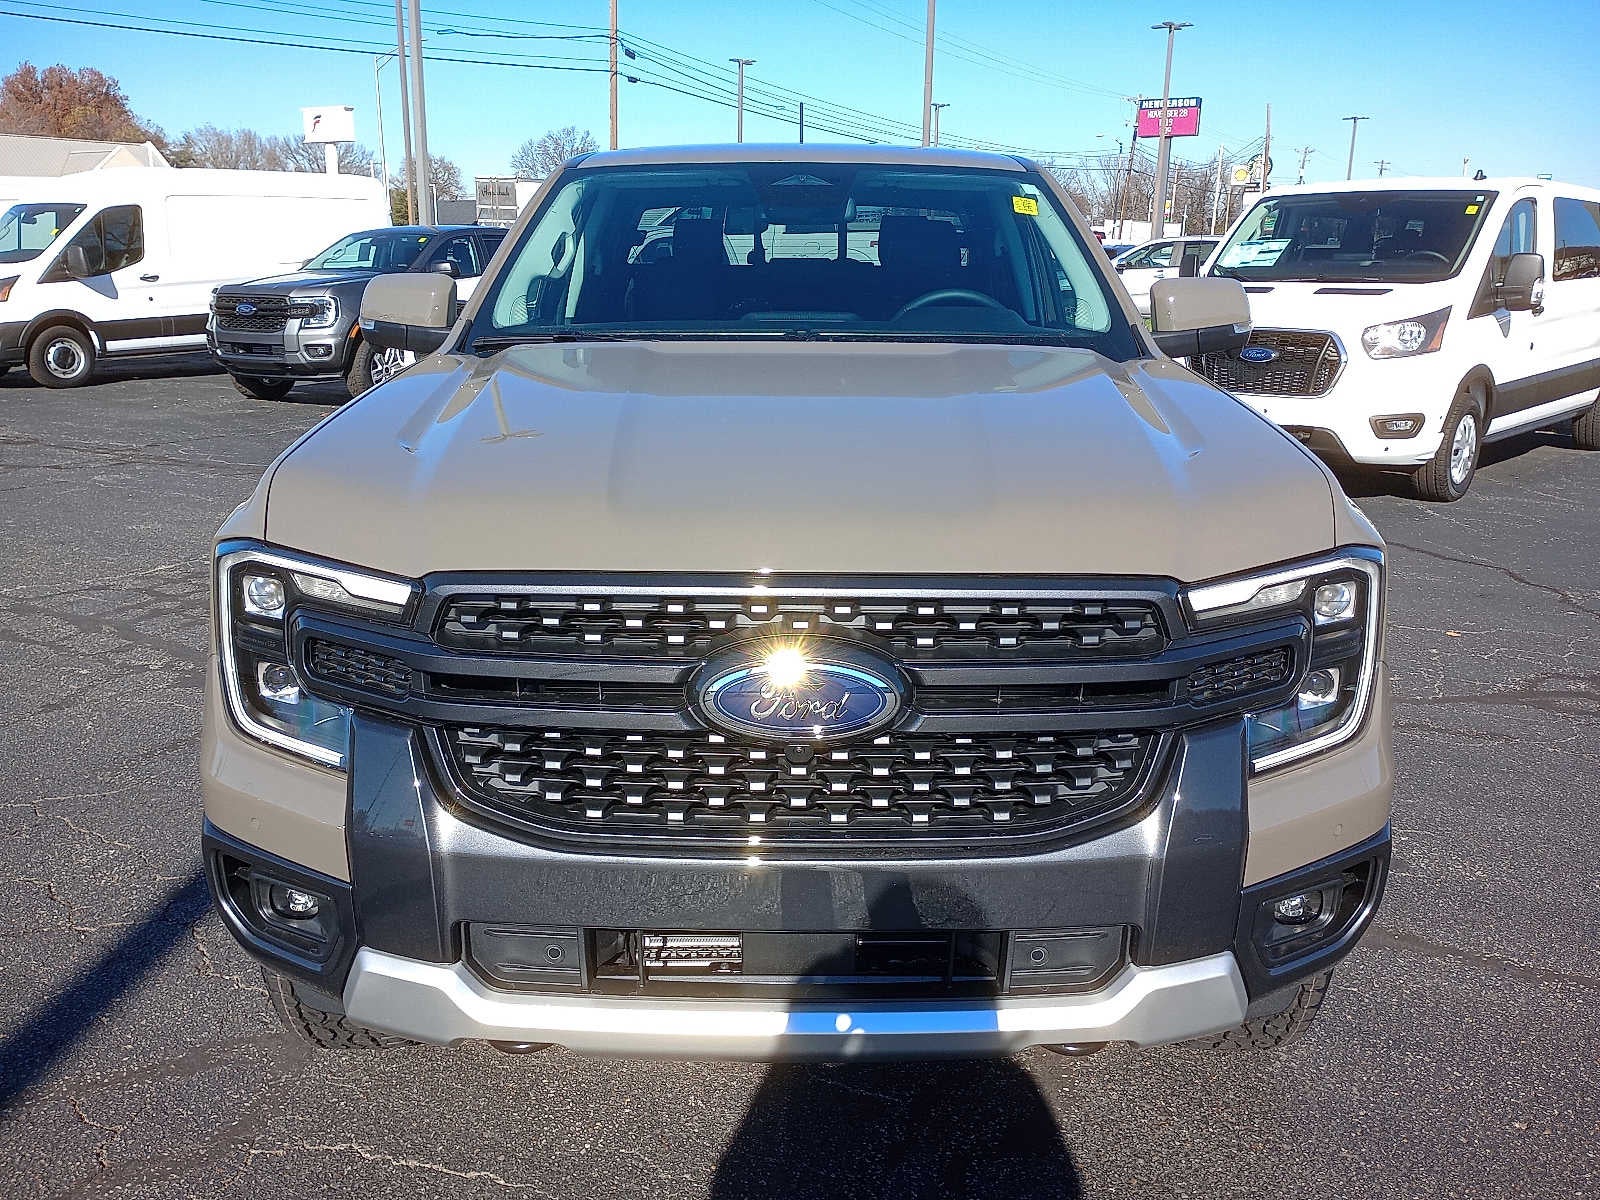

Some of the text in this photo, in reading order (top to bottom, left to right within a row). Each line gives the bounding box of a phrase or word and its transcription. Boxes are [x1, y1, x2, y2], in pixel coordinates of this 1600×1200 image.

[1147, 109, 1188, 119] NOVEBER 28
[750, 681, 851, 721] Ford
